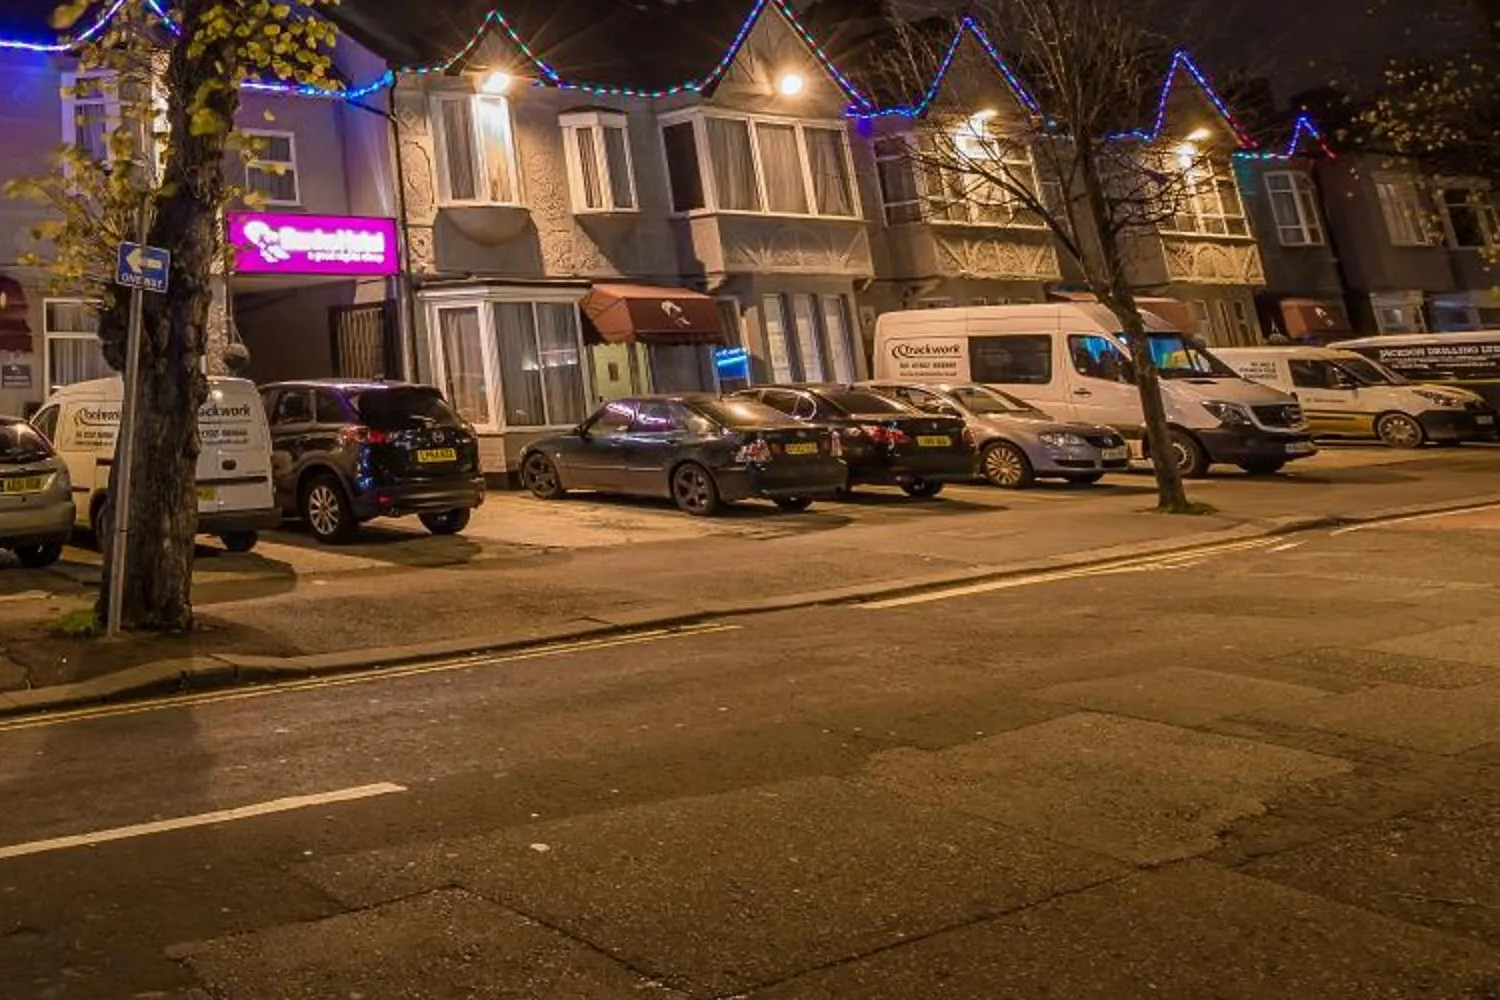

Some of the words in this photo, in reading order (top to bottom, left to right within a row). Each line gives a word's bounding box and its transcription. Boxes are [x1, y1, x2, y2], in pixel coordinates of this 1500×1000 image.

[121, 272, 141, 285] ONE
[143, 277, 163, 289] WAY
[198, 404, 250, 417] ackwork
